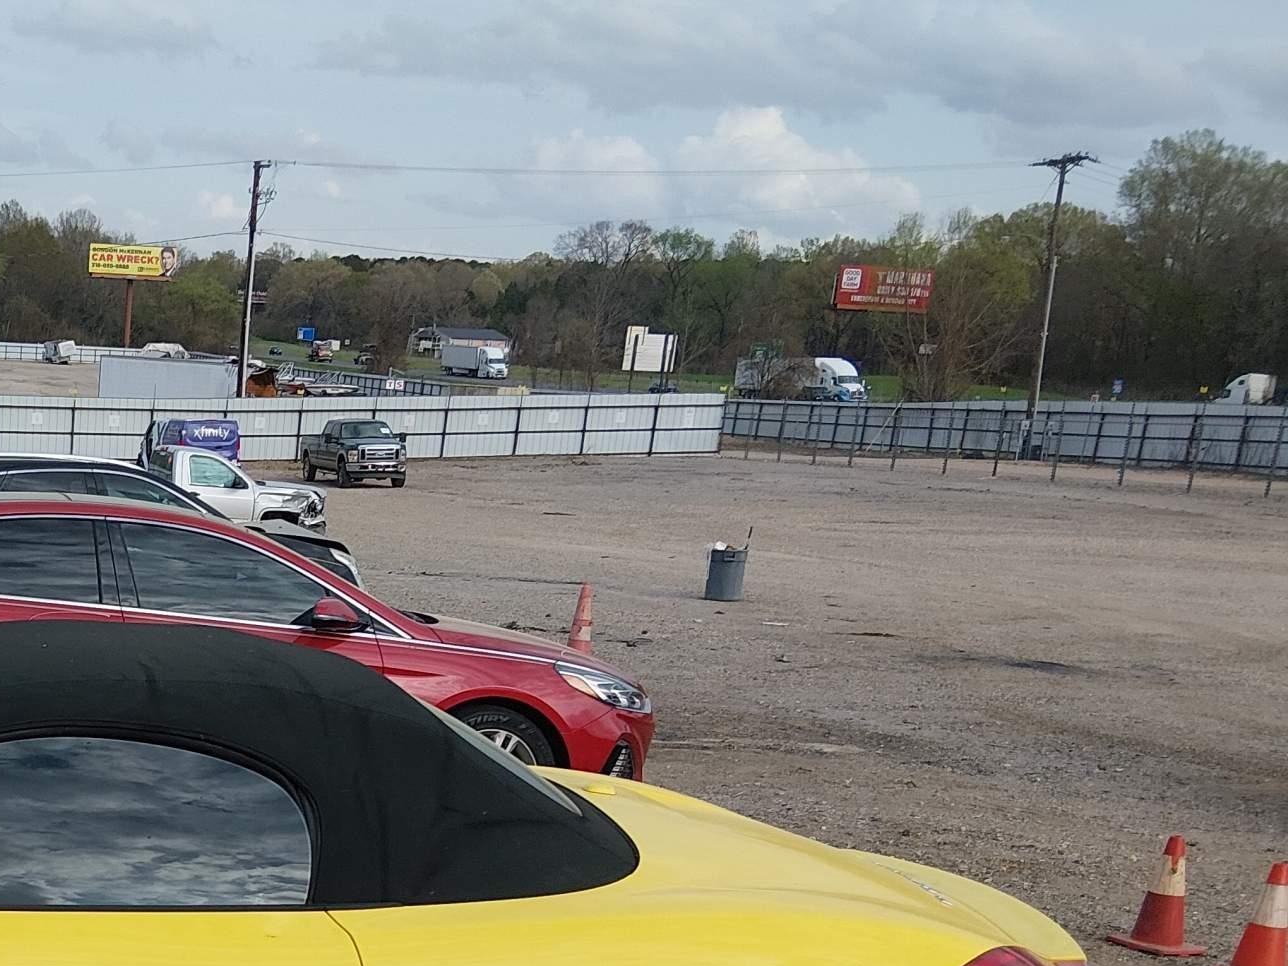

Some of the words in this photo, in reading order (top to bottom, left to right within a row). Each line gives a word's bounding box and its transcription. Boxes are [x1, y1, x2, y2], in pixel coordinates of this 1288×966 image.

[92, 253, 113, 262] CAR
[117, 255, 159, 264] WRECK?
[193, 425, 231, 441] xfinity
